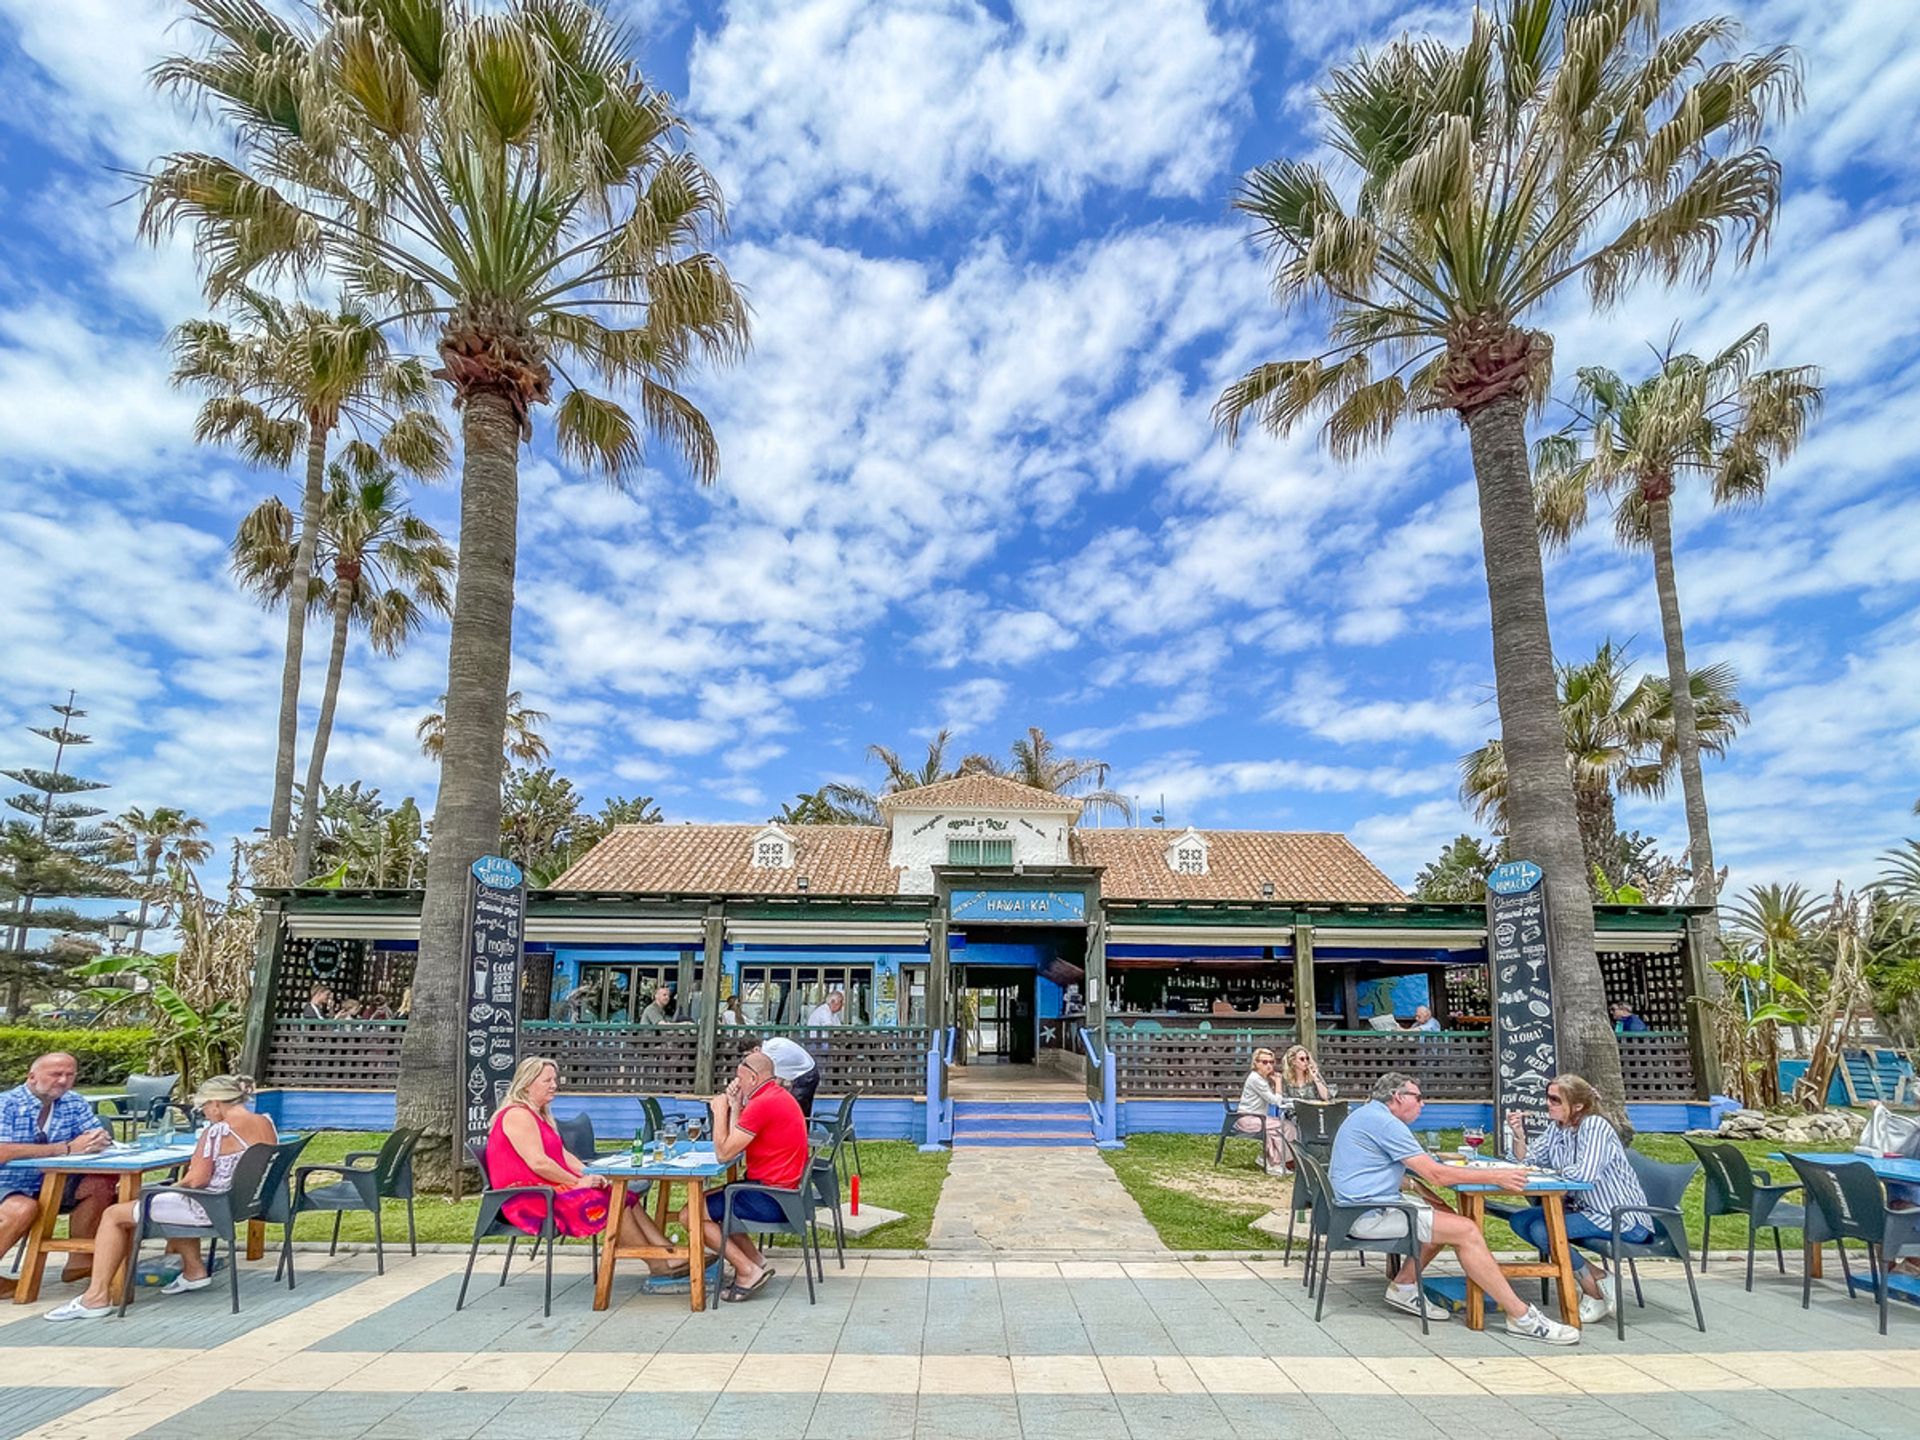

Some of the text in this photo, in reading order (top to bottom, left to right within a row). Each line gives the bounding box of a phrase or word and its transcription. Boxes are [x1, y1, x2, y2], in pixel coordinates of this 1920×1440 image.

[1500, 863, 1527, 877] PLAYA
[1508, 1028, 1544, 1045] ALOHA!
[468, 1105, 488, 1121] ICE
